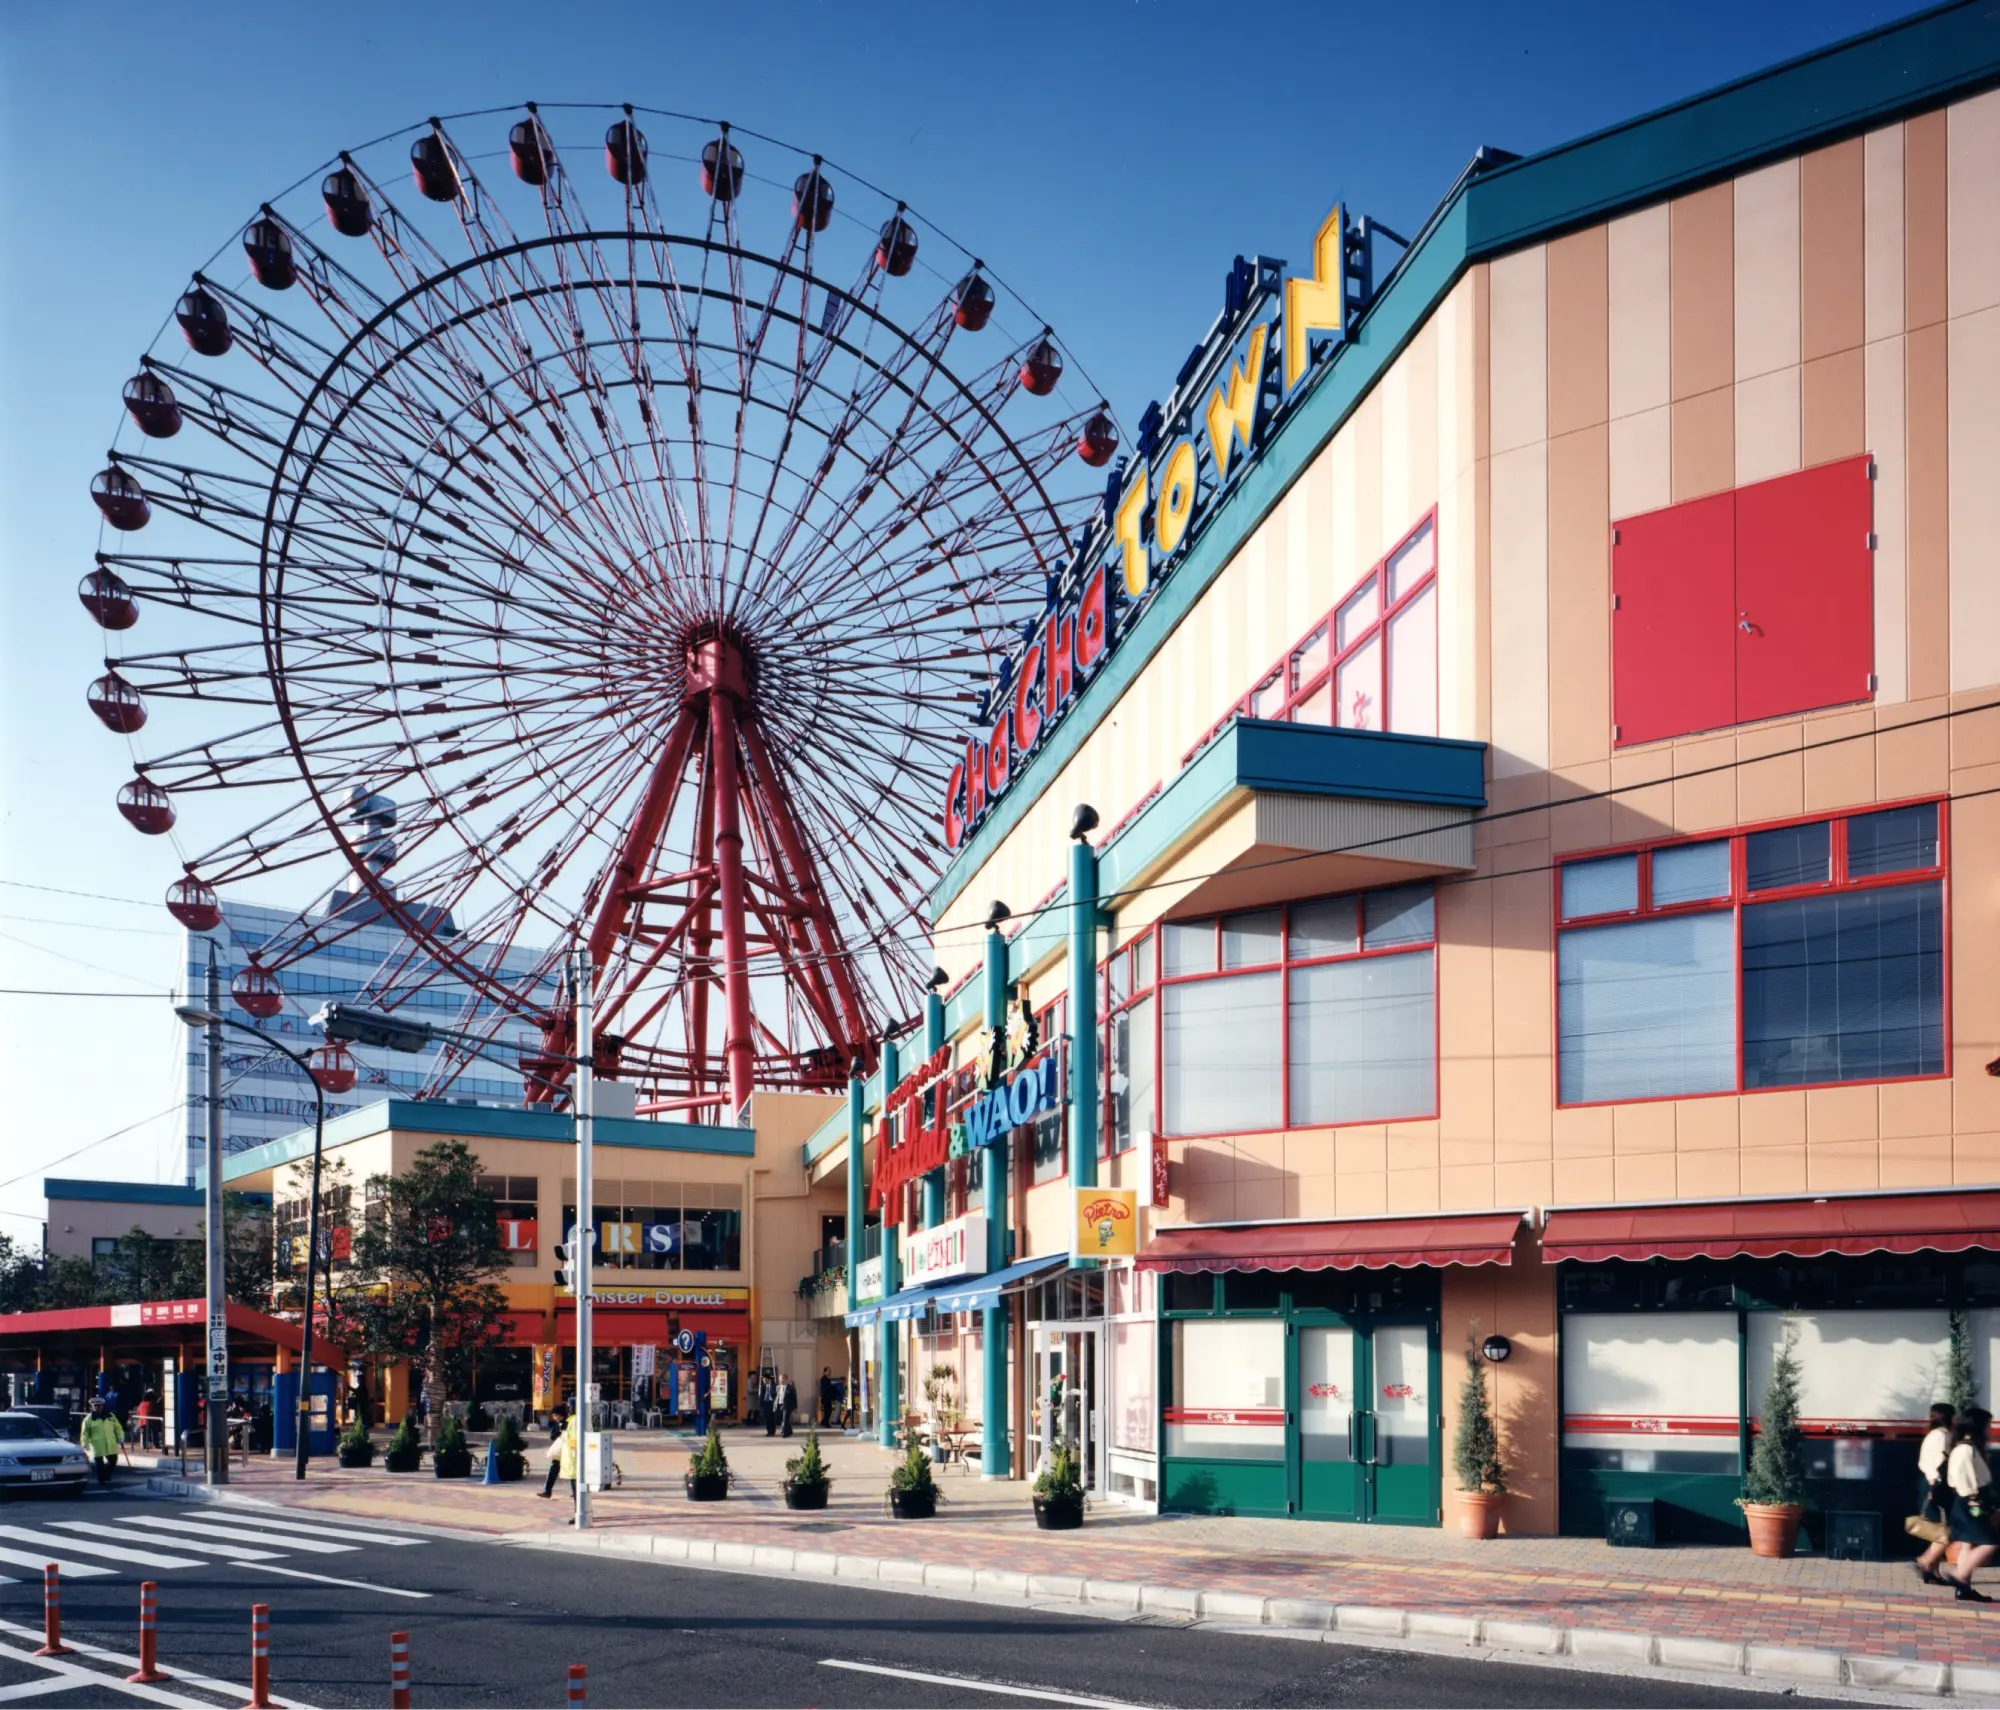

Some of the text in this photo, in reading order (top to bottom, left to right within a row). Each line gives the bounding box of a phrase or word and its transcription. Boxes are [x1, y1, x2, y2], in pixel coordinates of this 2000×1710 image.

[1114, 202, 1347, 602] TOWN
[949, 1123, 969, 1160] &
[963, 1057, 1056, 1151] WAO!
[1083, 1198, 1131, 1229] Pietro
[655, 1290, 725, 1305] Donut
[213, 1352, 225, 1375] 中村
